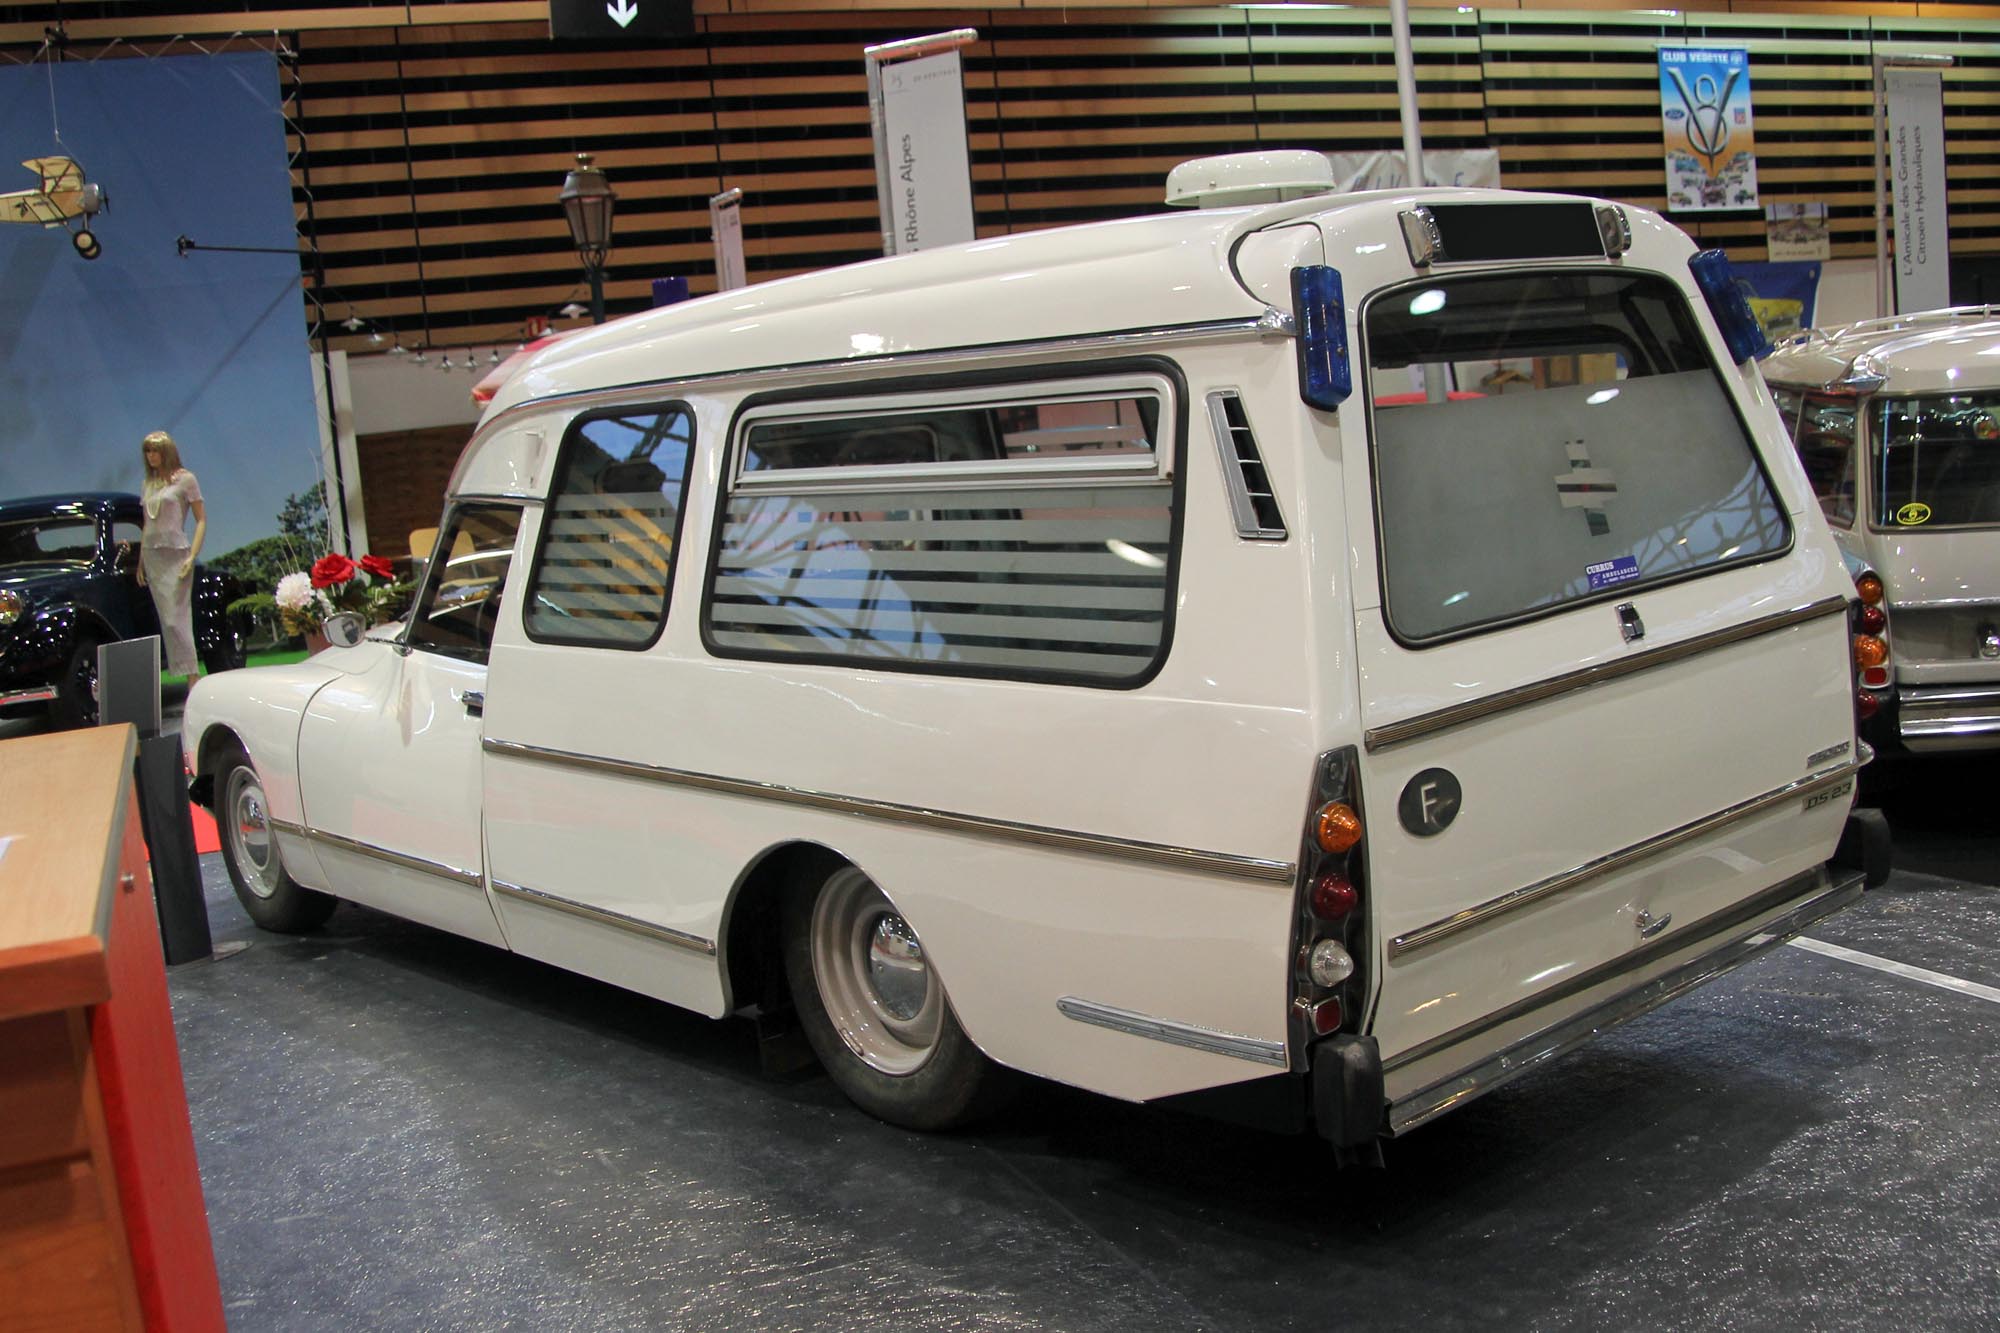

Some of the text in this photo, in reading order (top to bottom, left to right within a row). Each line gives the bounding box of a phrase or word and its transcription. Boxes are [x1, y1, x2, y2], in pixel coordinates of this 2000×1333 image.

[1662, 51, 1687, 63] CLUB
[899, 134, 915, 182] Alpes
[1912, 125, 1926, 212] Hydrauliques
[904, 187, 920, 243] Rhône
[1897, 125, 1913, 276] L'Amicale des Grandes
[1586, 561, 1614, 575] CURRUS
[1420, 782, 1437, 824] F
[1806, 782, 1852, 809] DS 23
